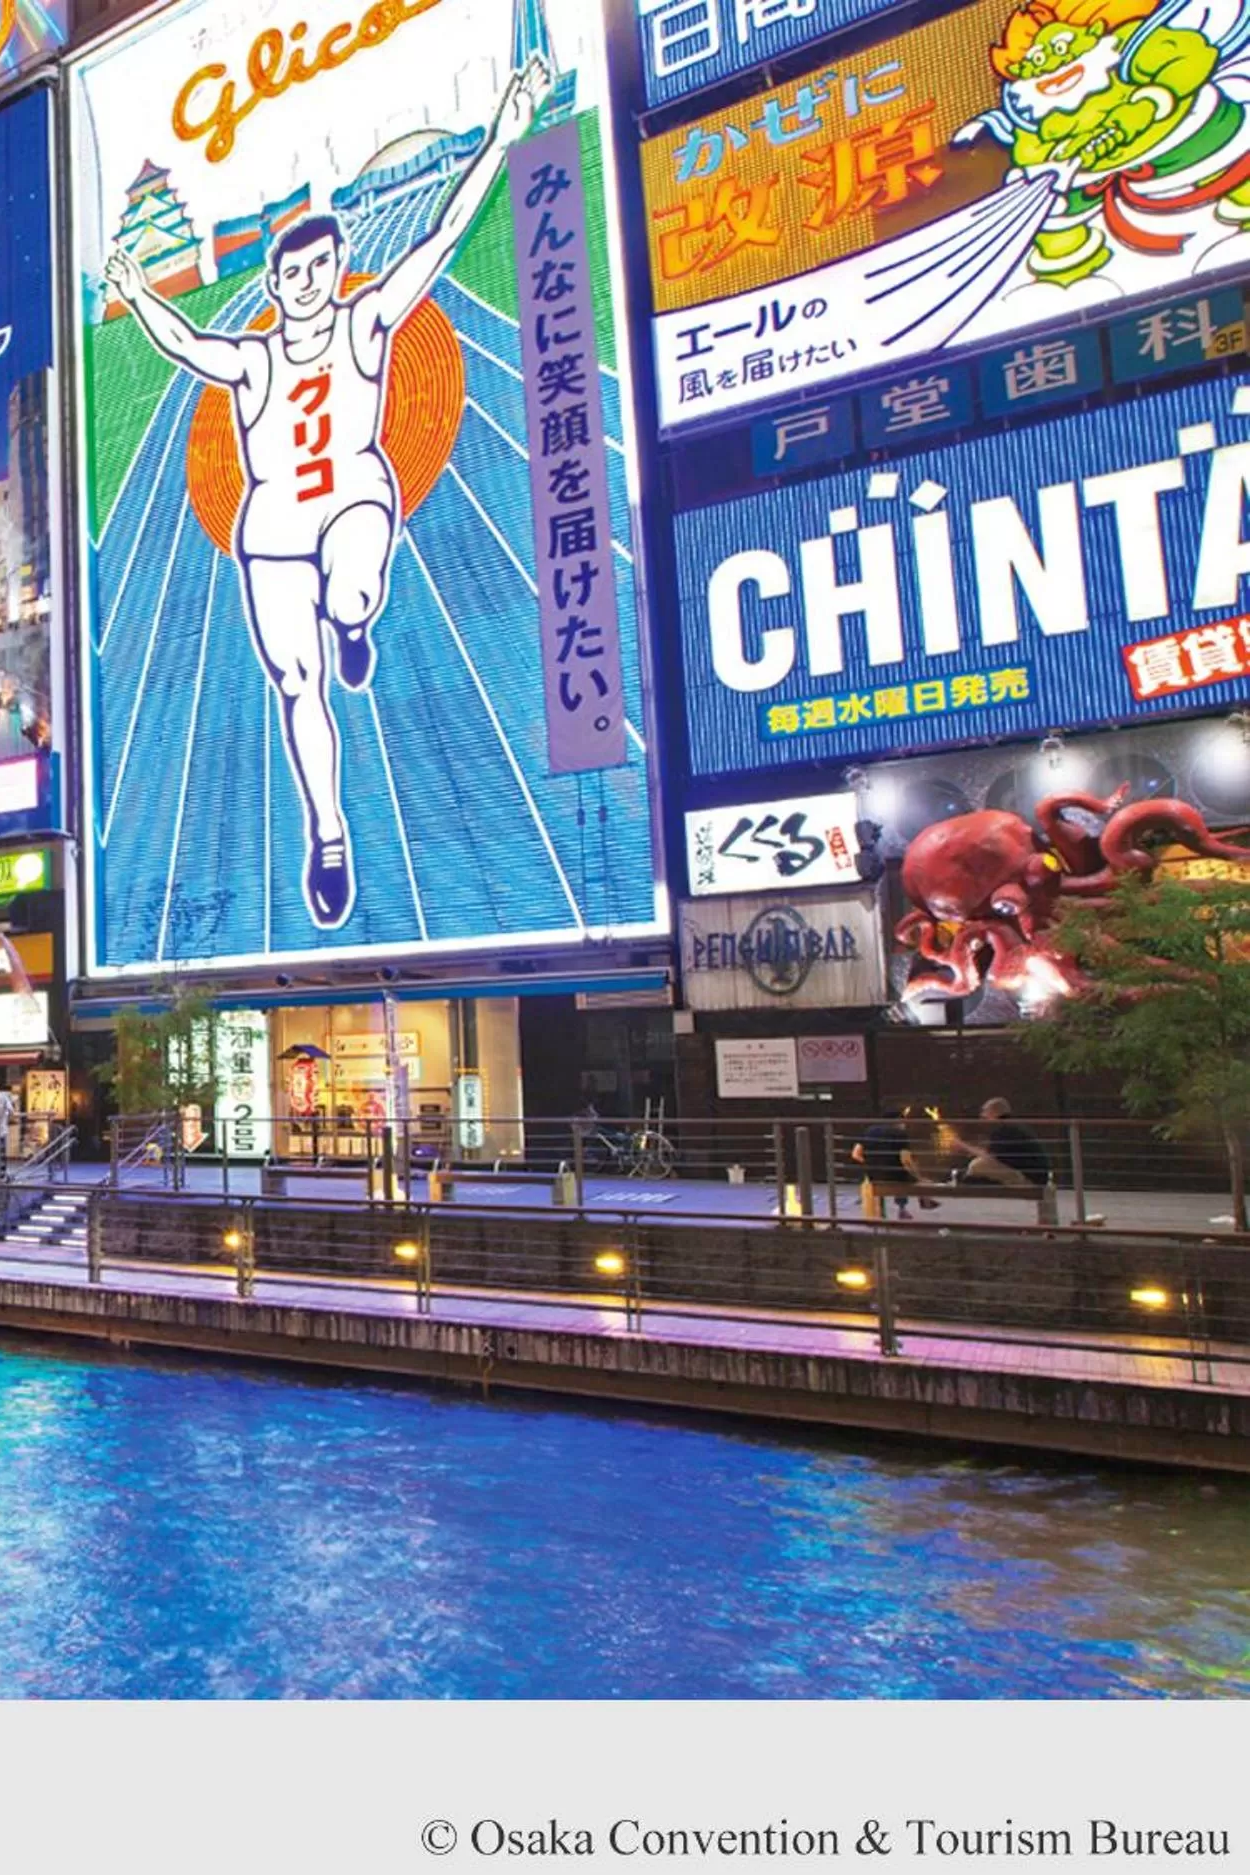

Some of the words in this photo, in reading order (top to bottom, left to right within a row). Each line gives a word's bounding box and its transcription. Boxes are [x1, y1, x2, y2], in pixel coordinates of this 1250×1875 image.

[672, 59, 906, 184] かぜに
[652, 98, 944, 281] 改源
[676, 298, 828, 361] エールの
[678, 338, 858, 404] 風を届けたい
[287, 362, 334, 503] グリコ
[525, 163, 611, 732] みんなに笑顔を届けたい。
[767, 667, 1031, 734] 毎週水曜日発売
[718, 812, 825, 877] くくる
